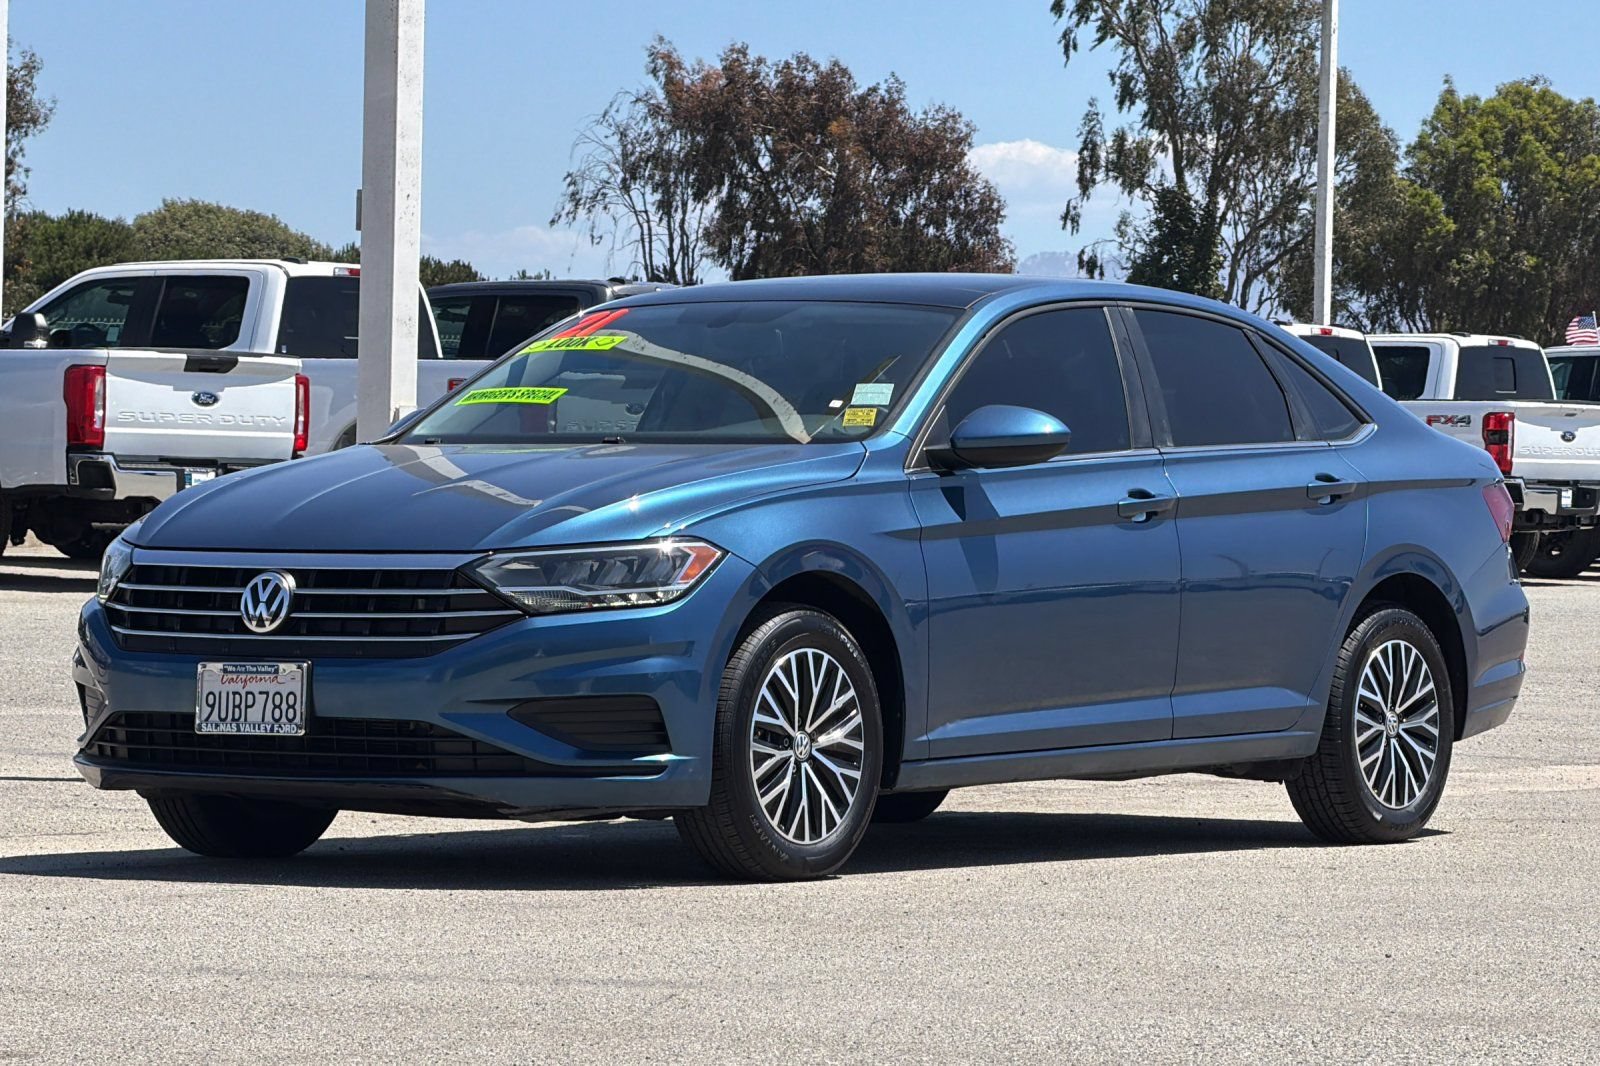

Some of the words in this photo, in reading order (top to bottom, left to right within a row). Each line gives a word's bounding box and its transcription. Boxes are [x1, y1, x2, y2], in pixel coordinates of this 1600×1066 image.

[545, 337, 595, 348] LOOK
[117, 411, 213, 424] SUPER
[219, 414, 286, 426] DUTY
[1426, 415, 1472, 427] FX4
[1519, 446, 1572, 456] SUPER
[220, 674, 286, 689] California
[204, 691, 297, 722] 9UBP788
[201, 723, 237, 732] SALINAS
[240, 724, 271, 733] VALLEY
[274, 724, 297, 733] FORD
